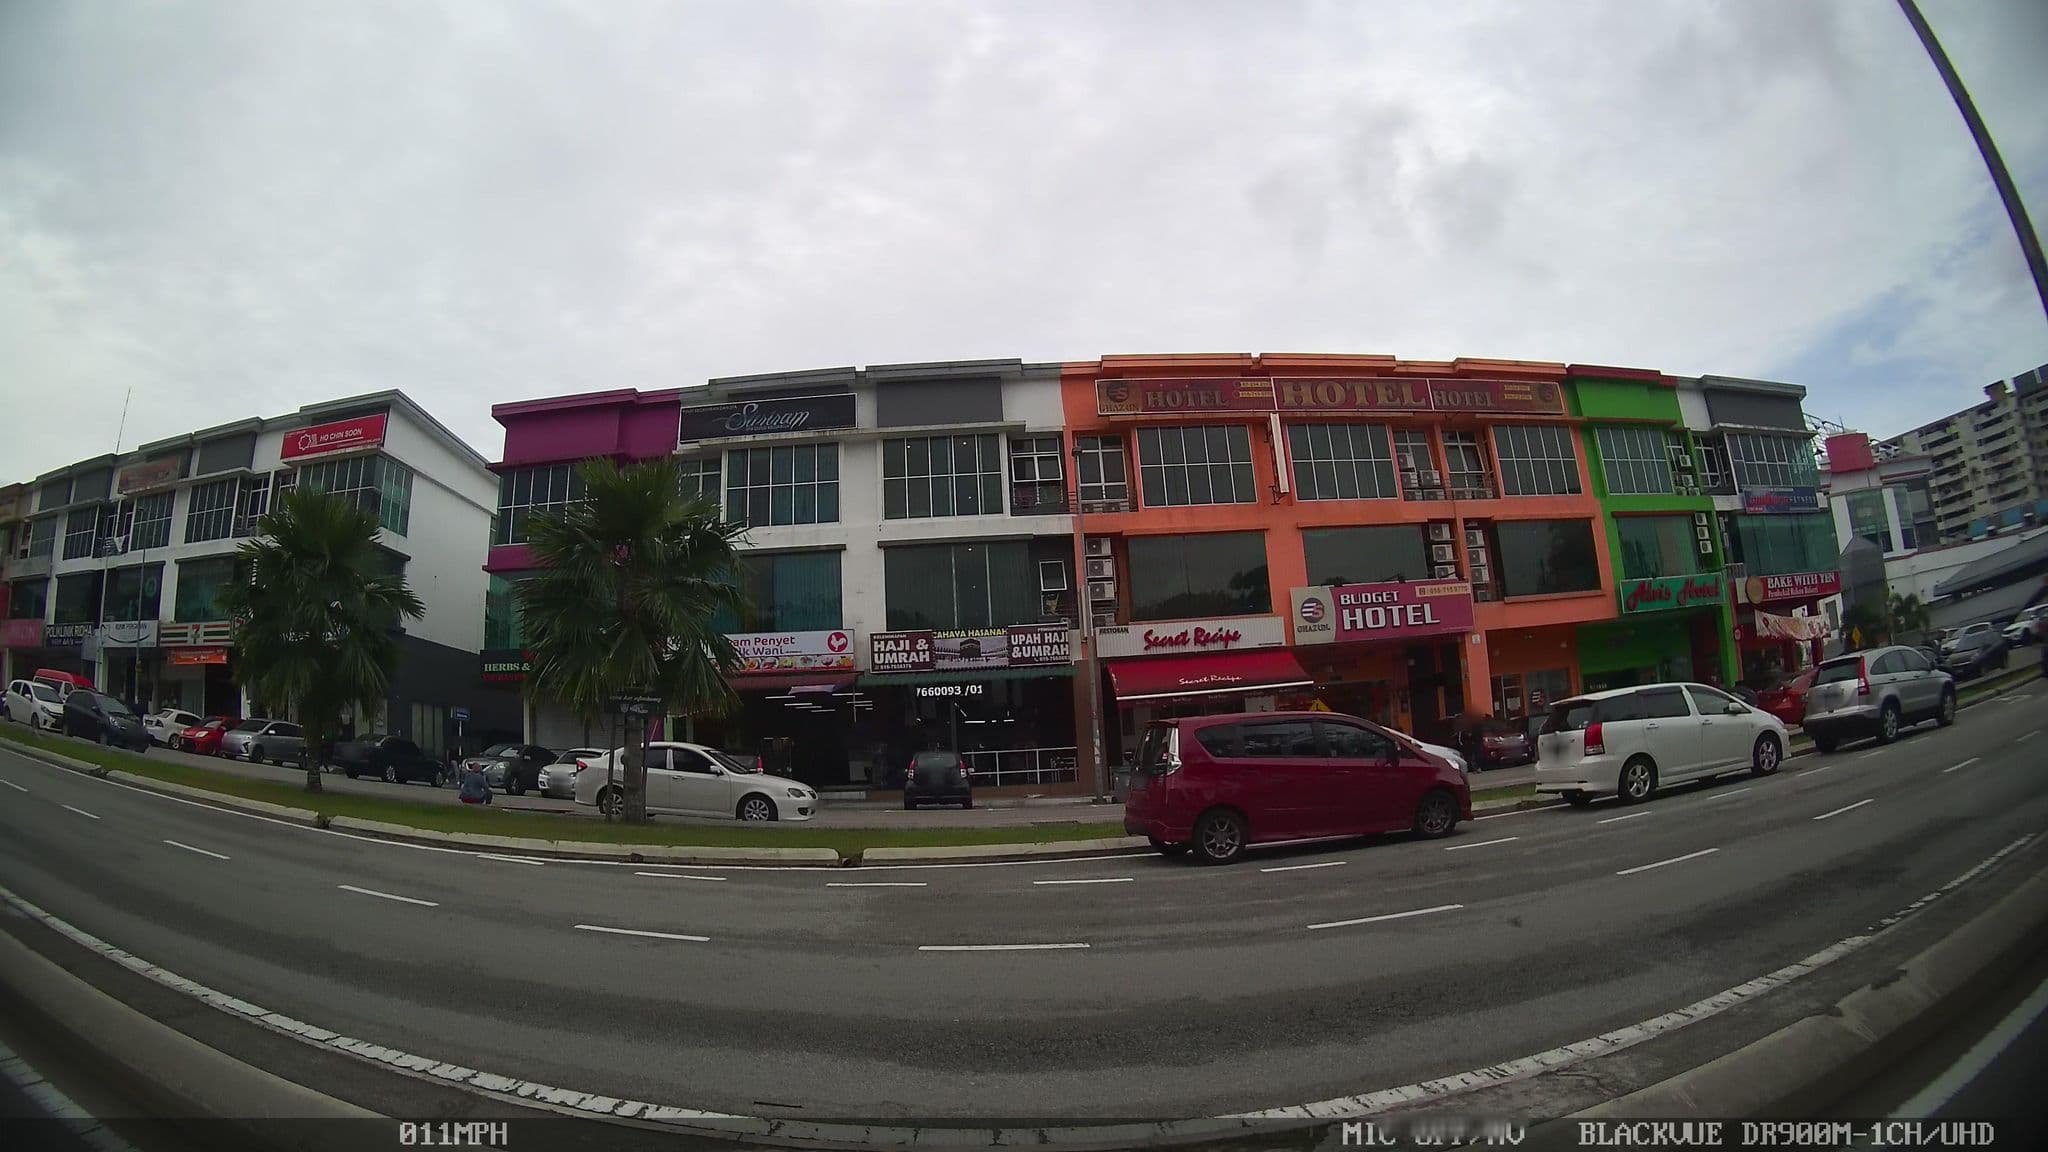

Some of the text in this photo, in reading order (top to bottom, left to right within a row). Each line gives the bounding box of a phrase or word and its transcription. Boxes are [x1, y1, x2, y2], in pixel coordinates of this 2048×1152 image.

[1145, 390, 1231, 408] HOTEL
[1281, 381, 1425, 408] HOTEL
[1434, 390, 1496, 408] HOTEL
[319, 433, 329, 442] HO
[329, 431, 344, 441] CHIN
[344, 427, 363, 438] SOON
[1767, 572, 1836, 589] BAKE WITH YEN
[1340, 591, 1400, 606] BUDGET
[1342, 603, 1441, 631] HOTEL
[932, 627, 1008, 639] CAHAYA HASANAH
[1011, 632, 1069, 645] UPAH HAJI
[1099, 627, 1129, 636] RESTORAN
[754, 636, 795, 648] Penyet
[874, 639, 929, 652] HAJI &
[1144, 627, 1242, 651] Secret Recipe
[752, 646, 784, 656] Wani
[874, 651, 930, 665] UMRAH
[484, 662, 531, 672] HERBS &
[1178, 674, 1242, 685] Secret Recipe
